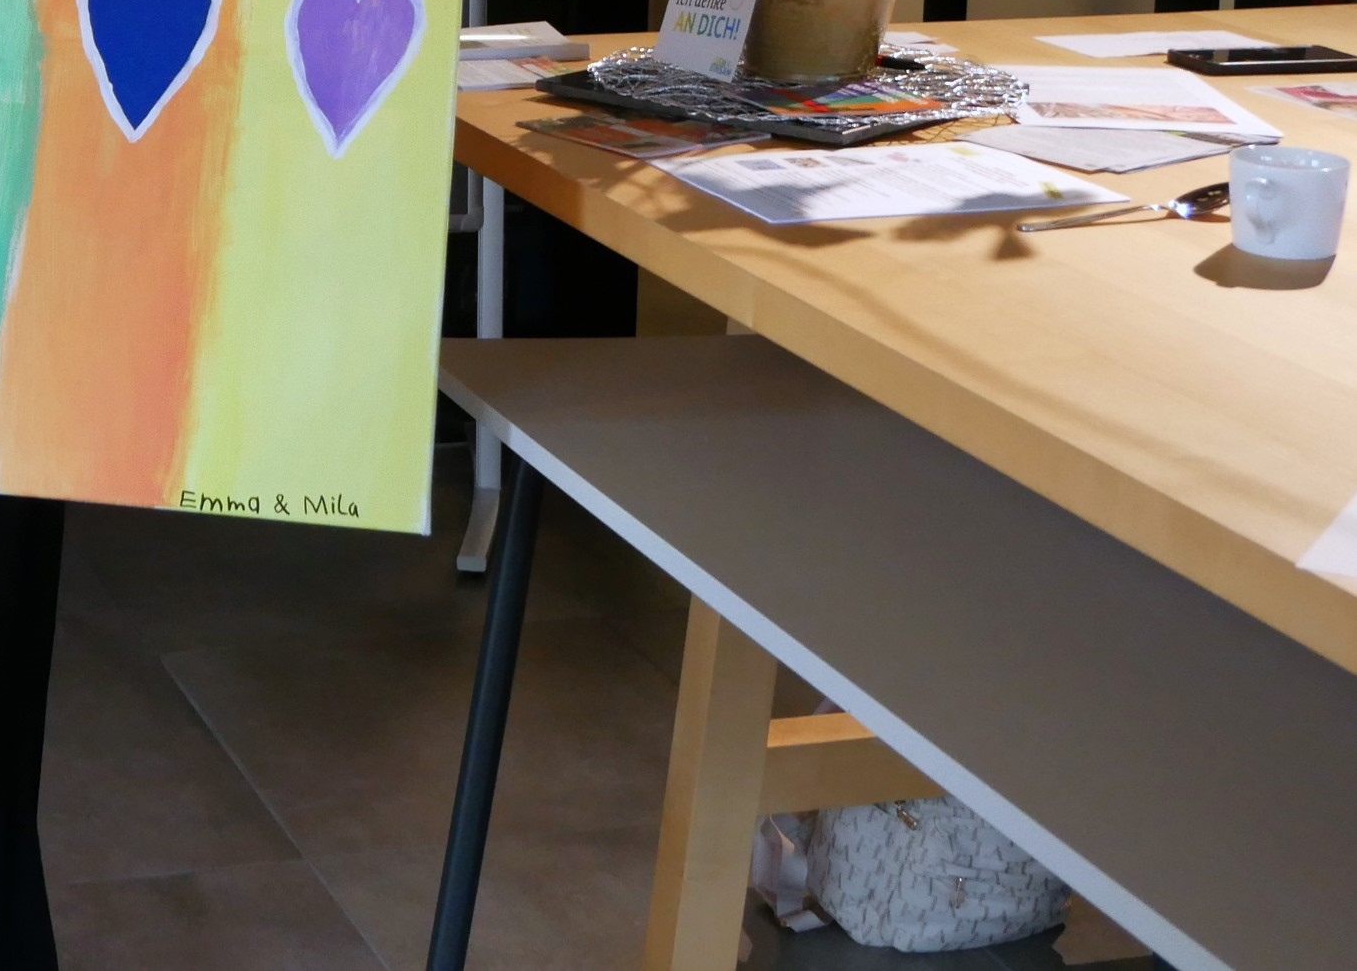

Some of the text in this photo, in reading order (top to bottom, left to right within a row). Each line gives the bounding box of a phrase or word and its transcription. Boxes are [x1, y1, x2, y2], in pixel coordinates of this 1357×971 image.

[673, 10, 741, 40] AN DICH!
[180, 490, 260, 515] Emma
[274, 493, 290, 516] &
